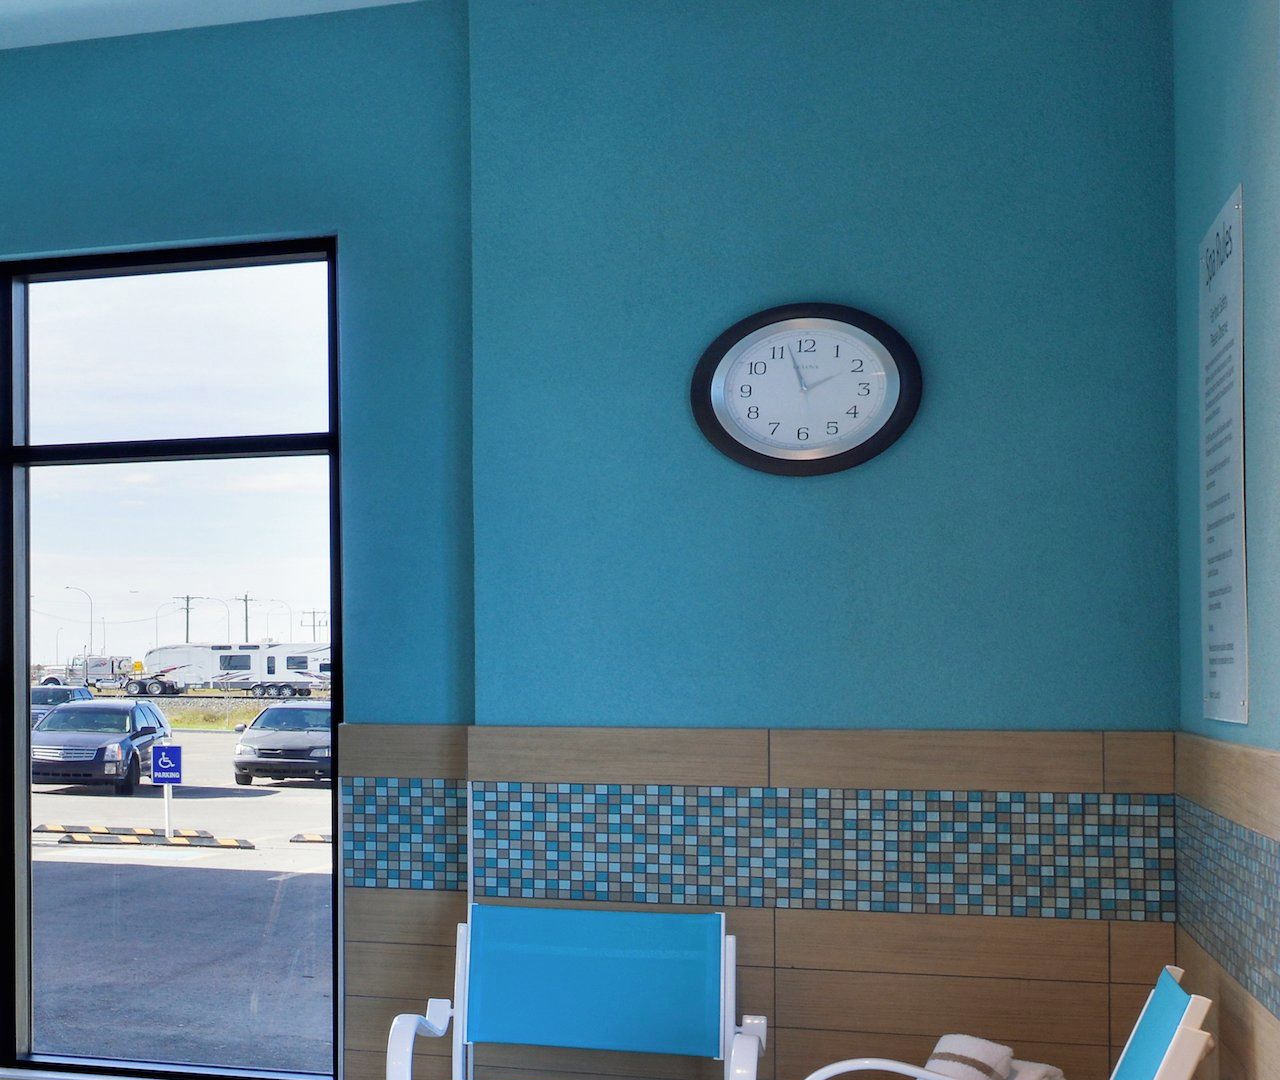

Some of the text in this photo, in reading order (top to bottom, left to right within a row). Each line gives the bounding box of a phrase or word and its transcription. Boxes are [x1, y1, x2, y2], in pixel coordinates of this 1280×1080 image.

[797, 338, 817, 353] 12
[832, 344, 841, 358] 1
[769, 346, 785, 360] 11
[748, 361, 767, 375] 10
[851, 359, 864, 373] 2
[739, 384, 752, 398] 9
[857, 382, 871, 396] 3
[747, 405, 759, 420] 8
[846, 405, 859, 419] 4
[768, 422, 781, 436] 7
[796, 427, 809, 441] 6
[825, 421, 839, 436] 5
